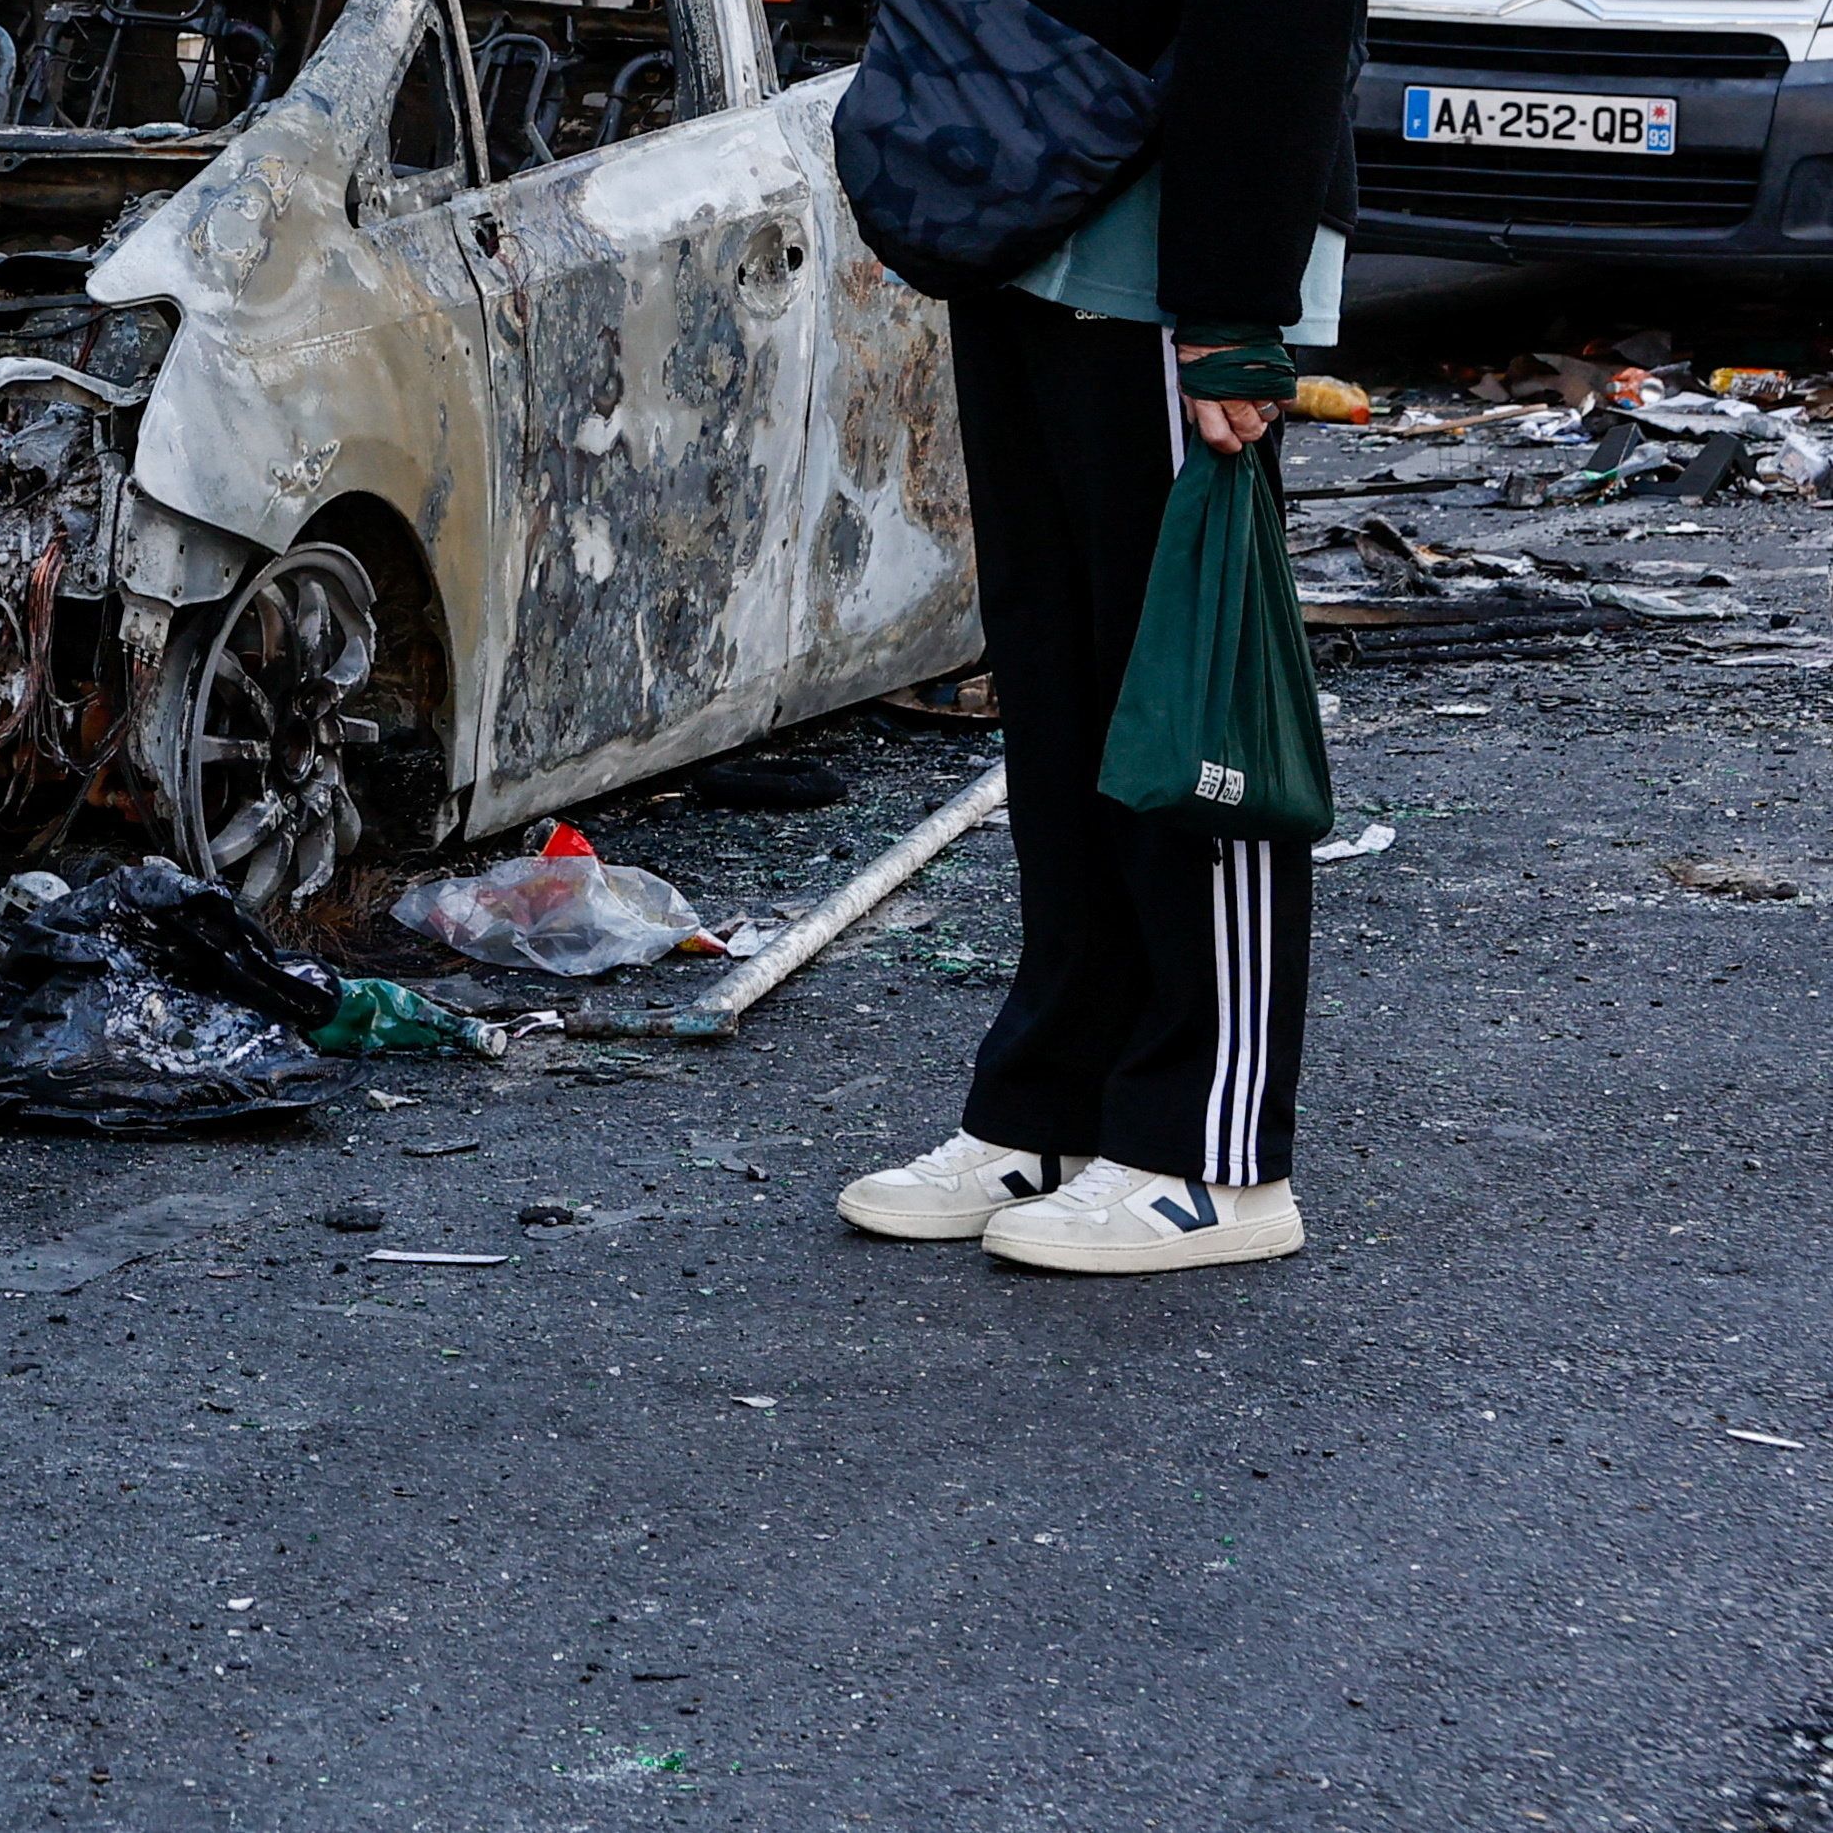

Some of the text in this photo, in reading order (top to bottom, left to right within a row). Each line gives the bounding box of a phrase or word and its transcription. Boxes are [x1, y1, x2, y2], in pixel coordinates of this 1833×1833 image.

[1413, 98, 1669, 147] F AA-252-QB 93
